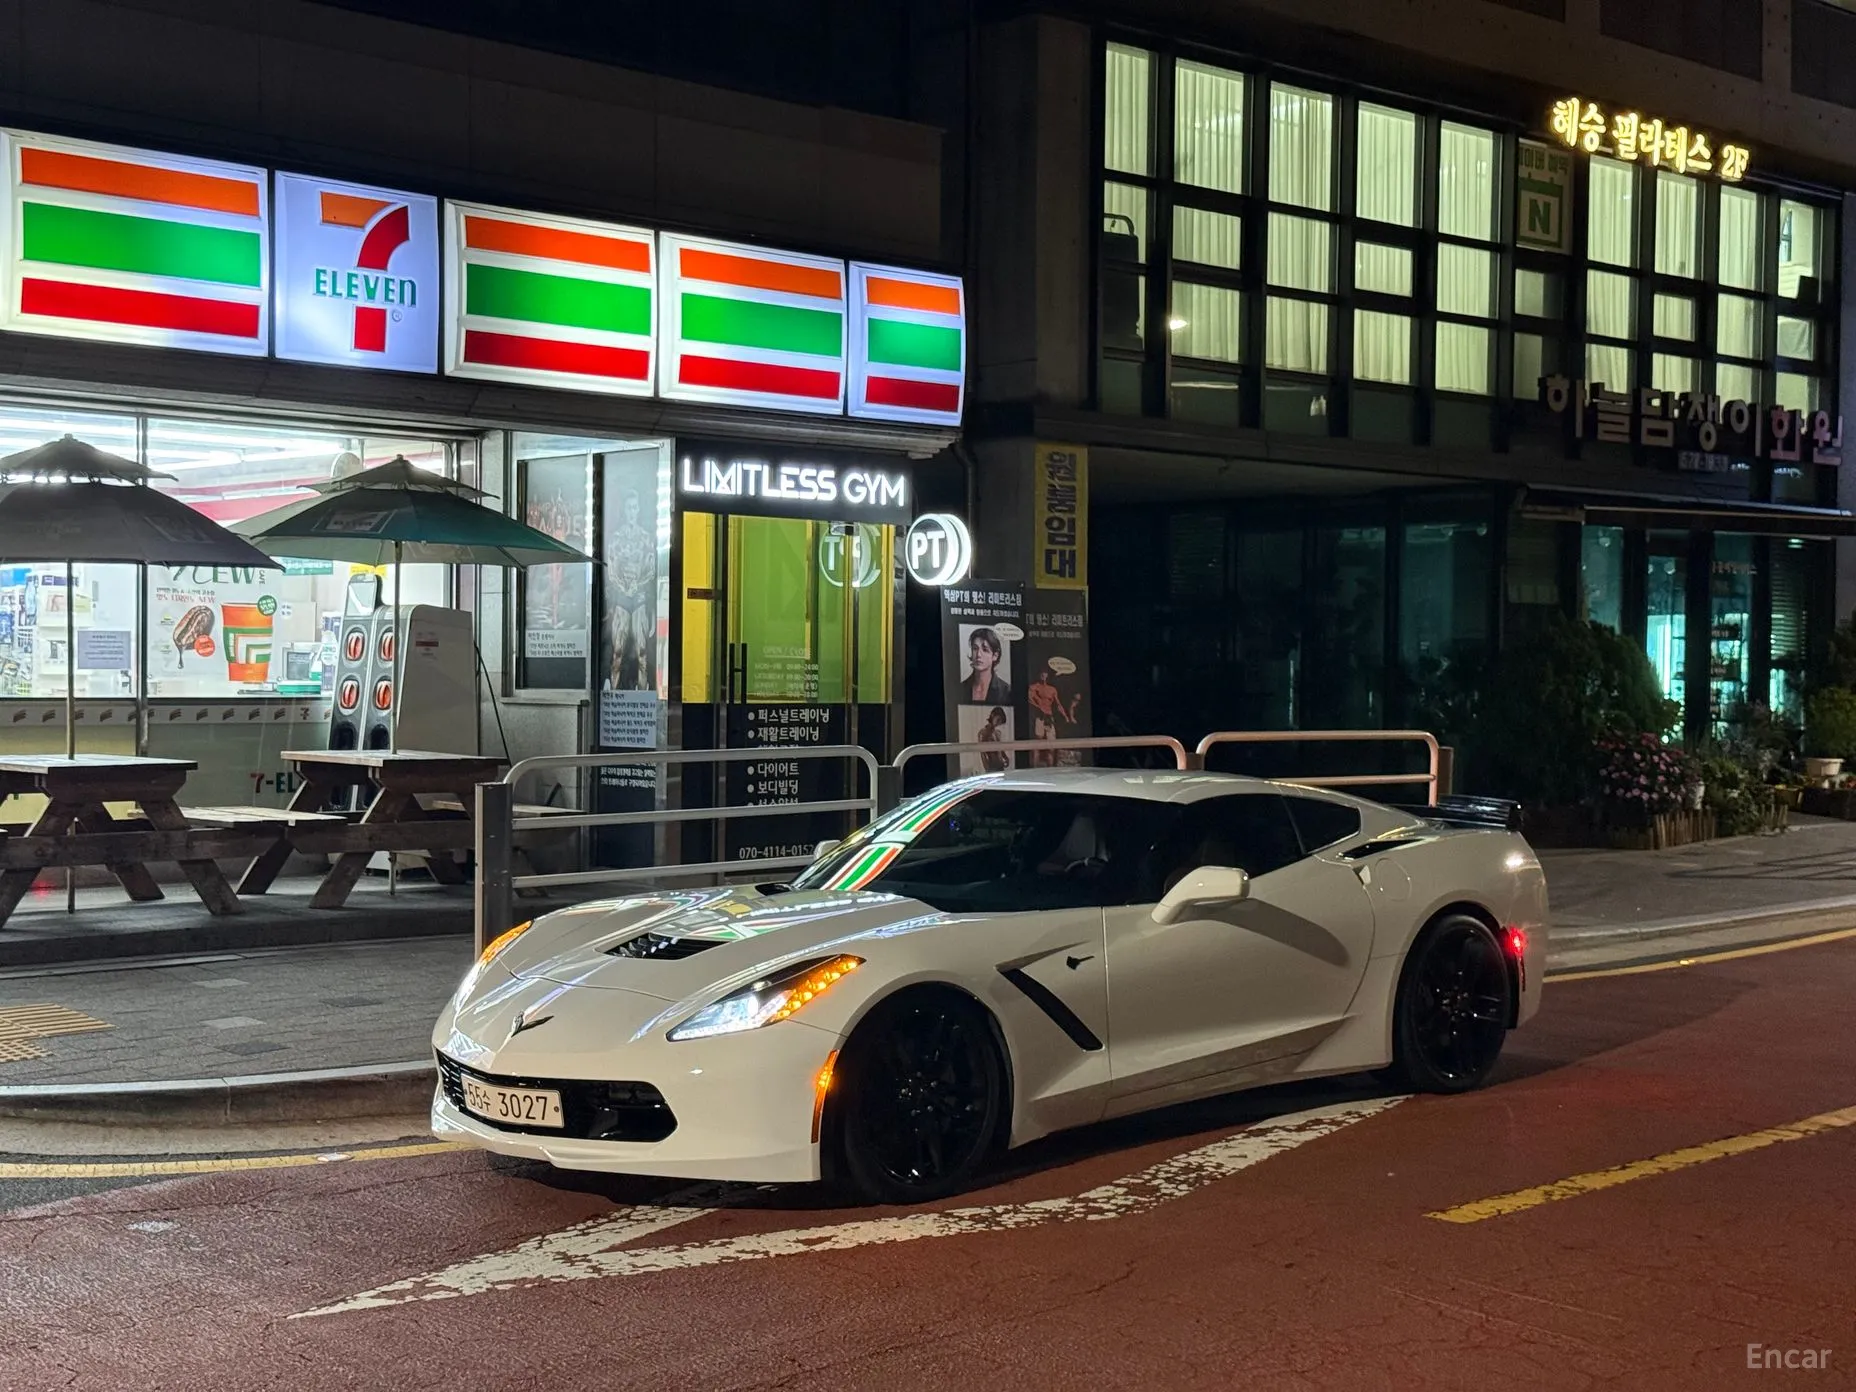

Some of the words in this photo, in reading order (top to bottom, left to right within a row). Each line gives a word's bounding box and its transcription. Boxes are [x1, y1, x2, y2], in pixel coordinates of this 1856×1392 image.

[1551, 96, 1606, 152] 혜승
[1611, 111, 1712, 174] 필라테스
[1720, 144, 1751, 180] 2F
[1528, 197, 1551, 234] N
[683, 457, 837, 502] LIMITLESS
[843, 471, 906, 507] GYM
[911, 530, 947, 571] PT
[757, 726, 820, 741] 재활트레이닝
[758, 708, 830, 723] 퍼스널트레이닝
[757, 762, 800, 777] 다이어트
[757, 780, 799, 795] 보디빌딩
[467, 1082, 491, 1112] 55수
[497, 1092, 548, 1121] 3027
